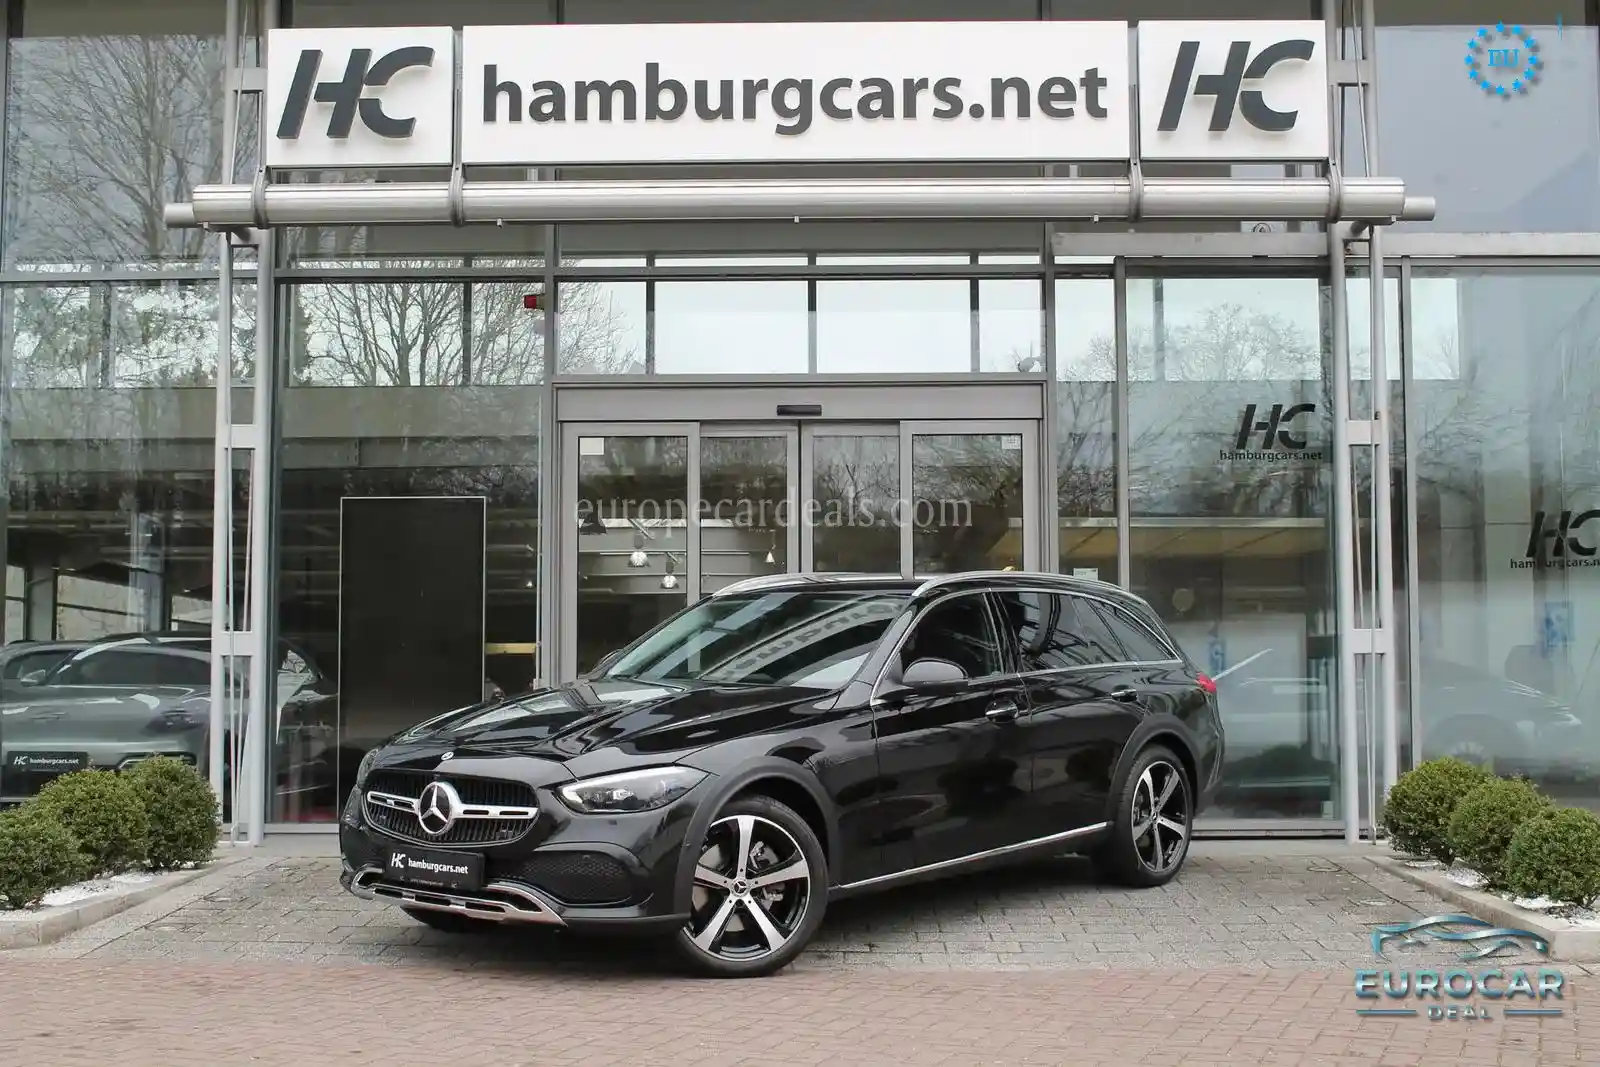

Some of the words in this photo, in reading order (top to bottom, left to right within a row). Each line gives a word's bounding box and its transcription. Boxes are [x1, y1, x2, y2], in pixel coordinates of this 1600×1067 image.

[276, 45, 435, 140] HC
[482, 62, 1108, 134] hamburgcars.net
[1157, 38, 1316, 132] HC
[1235, 403, 1316, 450] HC
[1220, 450, 1323, 462] hamburgcars.net
[1526, 509, 1600, 556] HC
[1510, 559, 1600, 571] hamurgcars.n
[390, 852, 406, 869] HC
[407, 858, 469, 874] hamburgcars.net
